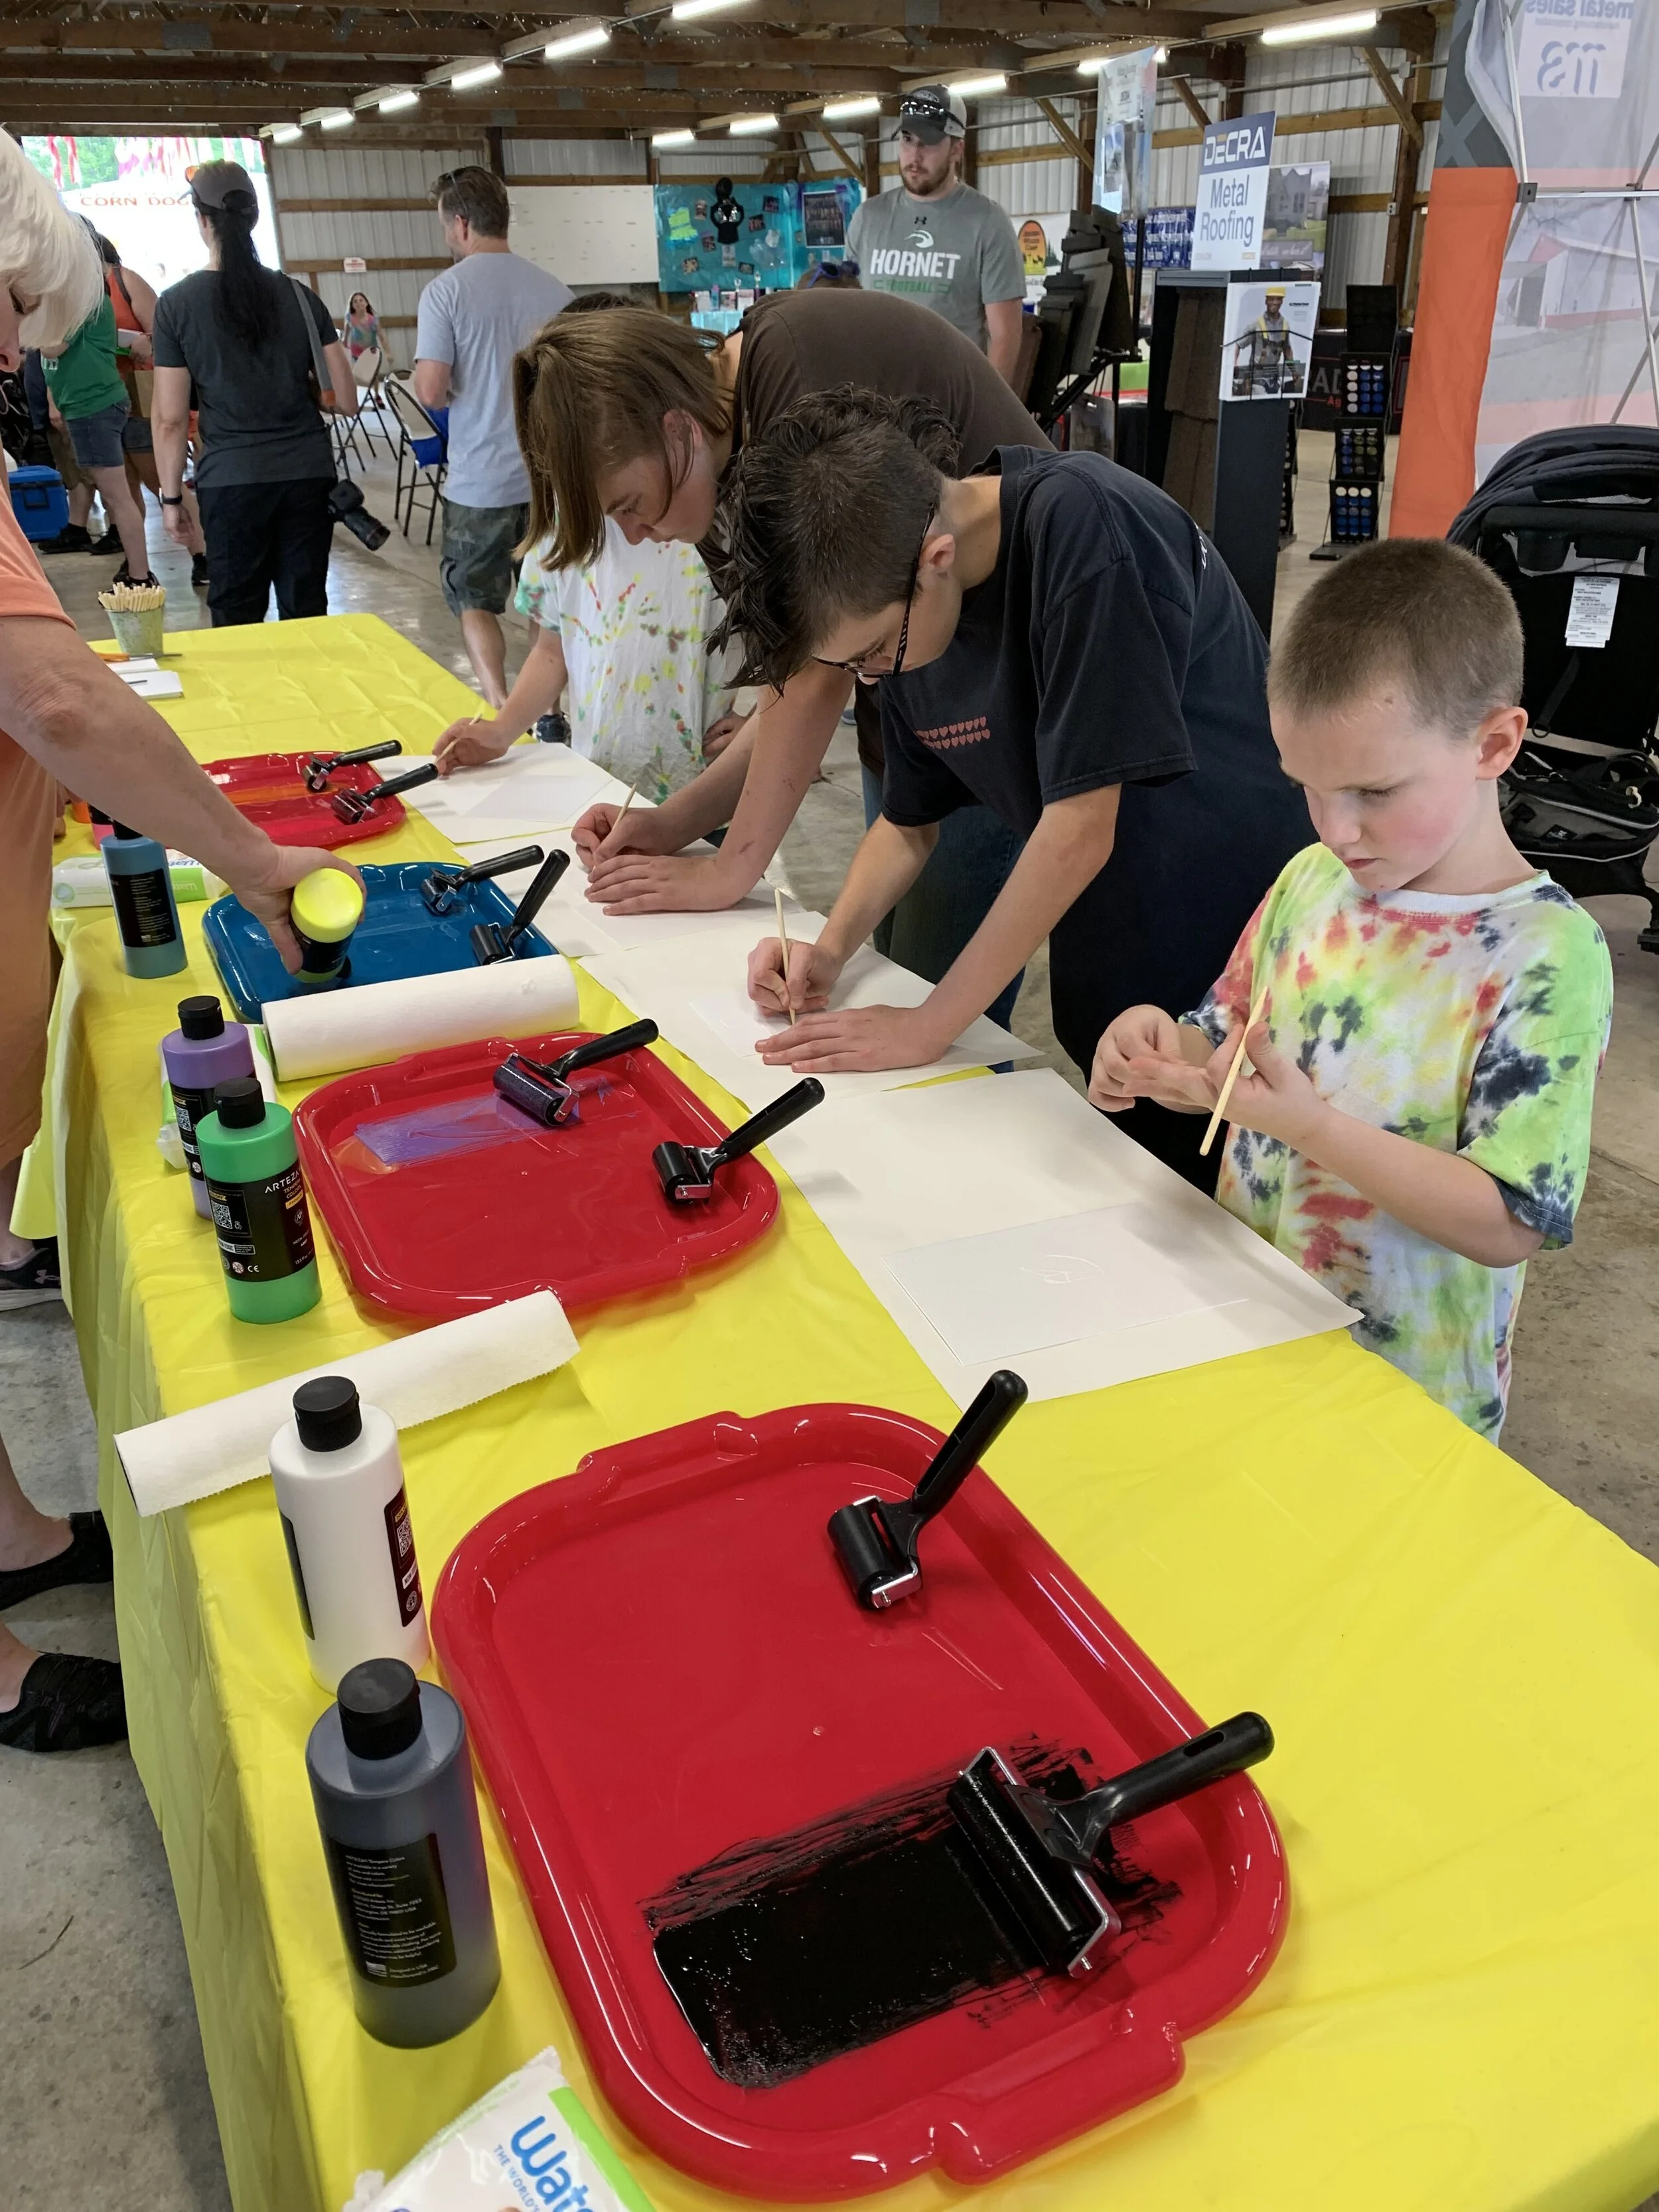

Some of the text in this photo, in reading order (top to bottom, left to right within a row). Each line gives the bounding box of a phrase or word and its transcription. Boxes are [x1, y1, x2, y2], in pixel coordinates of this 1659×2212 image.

[80, 197, 137, 206] CORN
[1210, 175, 1250, 209] Metal
[1200, 210, 1254, 247] Roofing
[870, 249, 961, 279] HORNET
[265, 1170, 299, 1193] ARTEZA
[494, 2144, 510, 2167] THE
[510, 2116, 595, 2212] Wat
